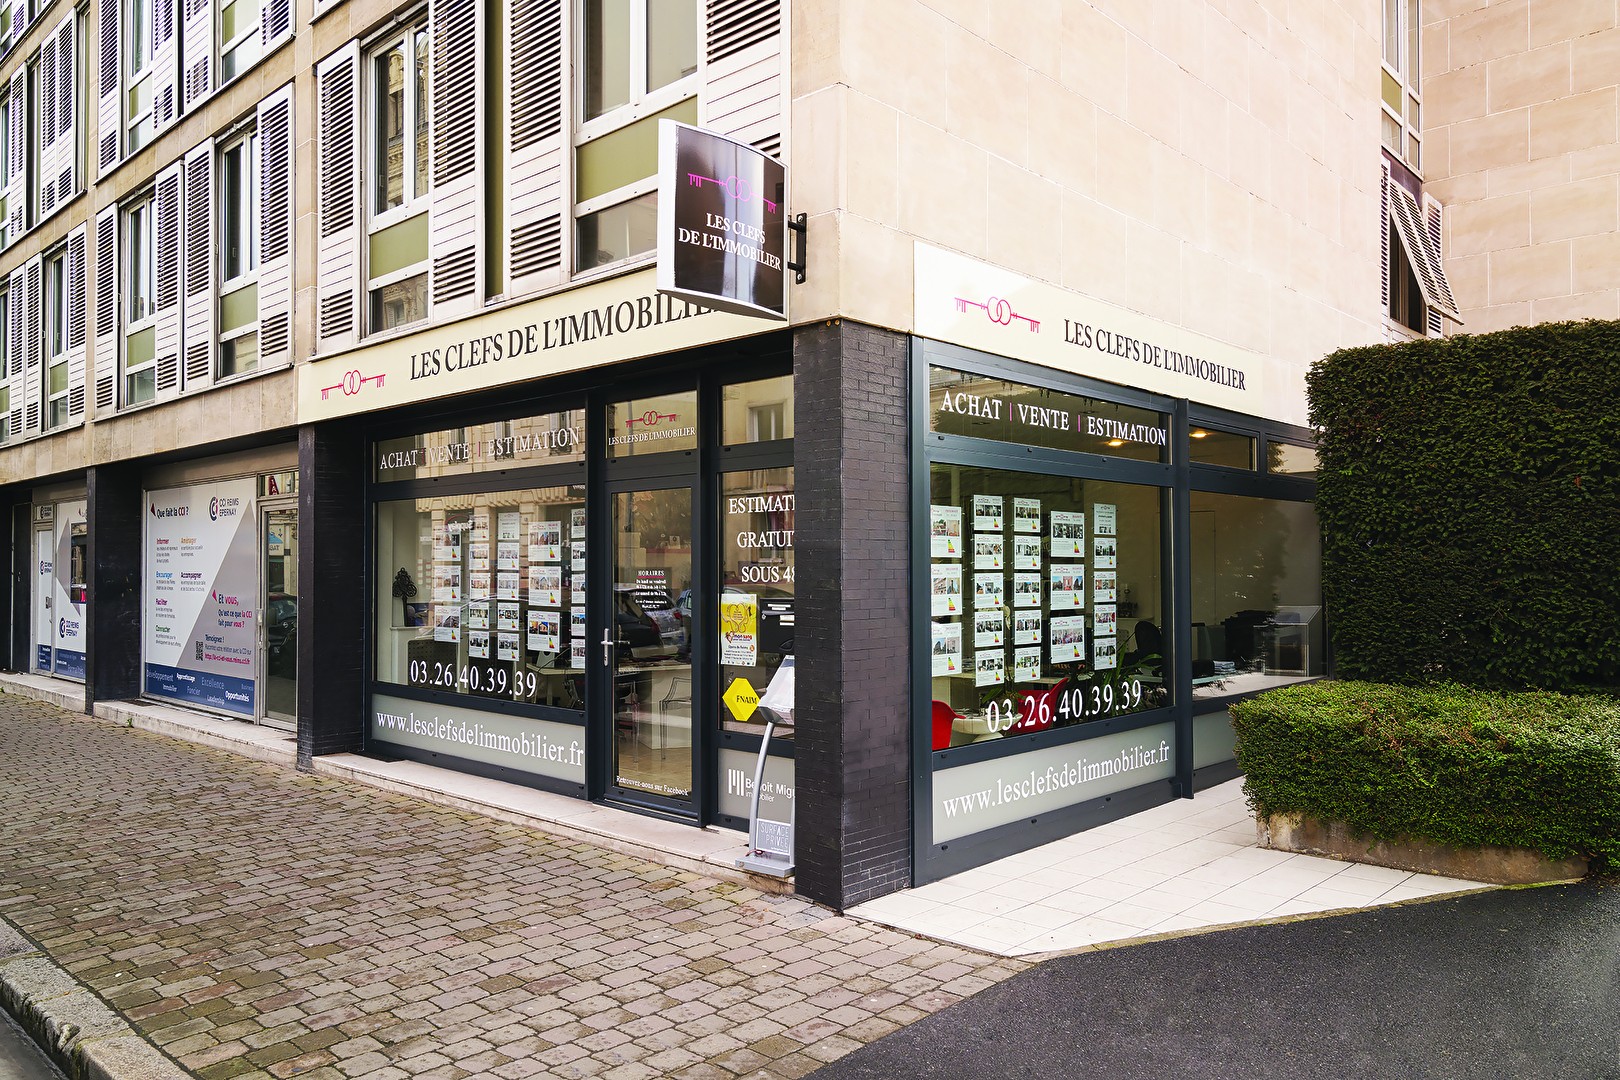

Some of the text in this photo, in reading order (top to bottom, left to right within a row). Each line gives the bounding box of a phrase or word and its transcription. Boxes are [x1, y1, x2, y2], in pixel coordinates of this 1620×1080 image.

[706, 212, 766, 244] LES CLEFS
[678, 228, 782, 272] DE L'IMMOBILIER
[410, 291, 718, 381] LES CLEFS DE L'IMMOBILI
[1064, 319, 1246, 391] LES CLEFS DE L'IMMOBILIER
[941, 390, 1166, 446] ACHAT VENTE ESTIMATION
[380, 426, 580, 470] ACHAT VENTE ESTIMATION
[608, 426, 696, 446] LES CLEFS DE L'IMMOBILIER
[741, 566, 780, 582] SOUS
[219, 594, 239, 606] Et vous,
[187, 686, 200, 695] Foncier
[202, 677, 224, 690] Excellence
[410, 660, 537, 698] 03.26.40.39.39
[736, 696, 757, 705] FNAIM
[986, 680, 1142, 734] 03.26.40.39.39
[376, 712, 584, 766] www.lesclefsdelimmobilier.fr
[616, 776, 654, 792] Retrouvez-nous
[664, 784, 689, 796] Facebook
[746, 778, 773, 792] Beoit
[942, 740, 1170, 819] www.lesclefsdelimmobilier.fr
[760, 823, 789, 837] SURFACE
